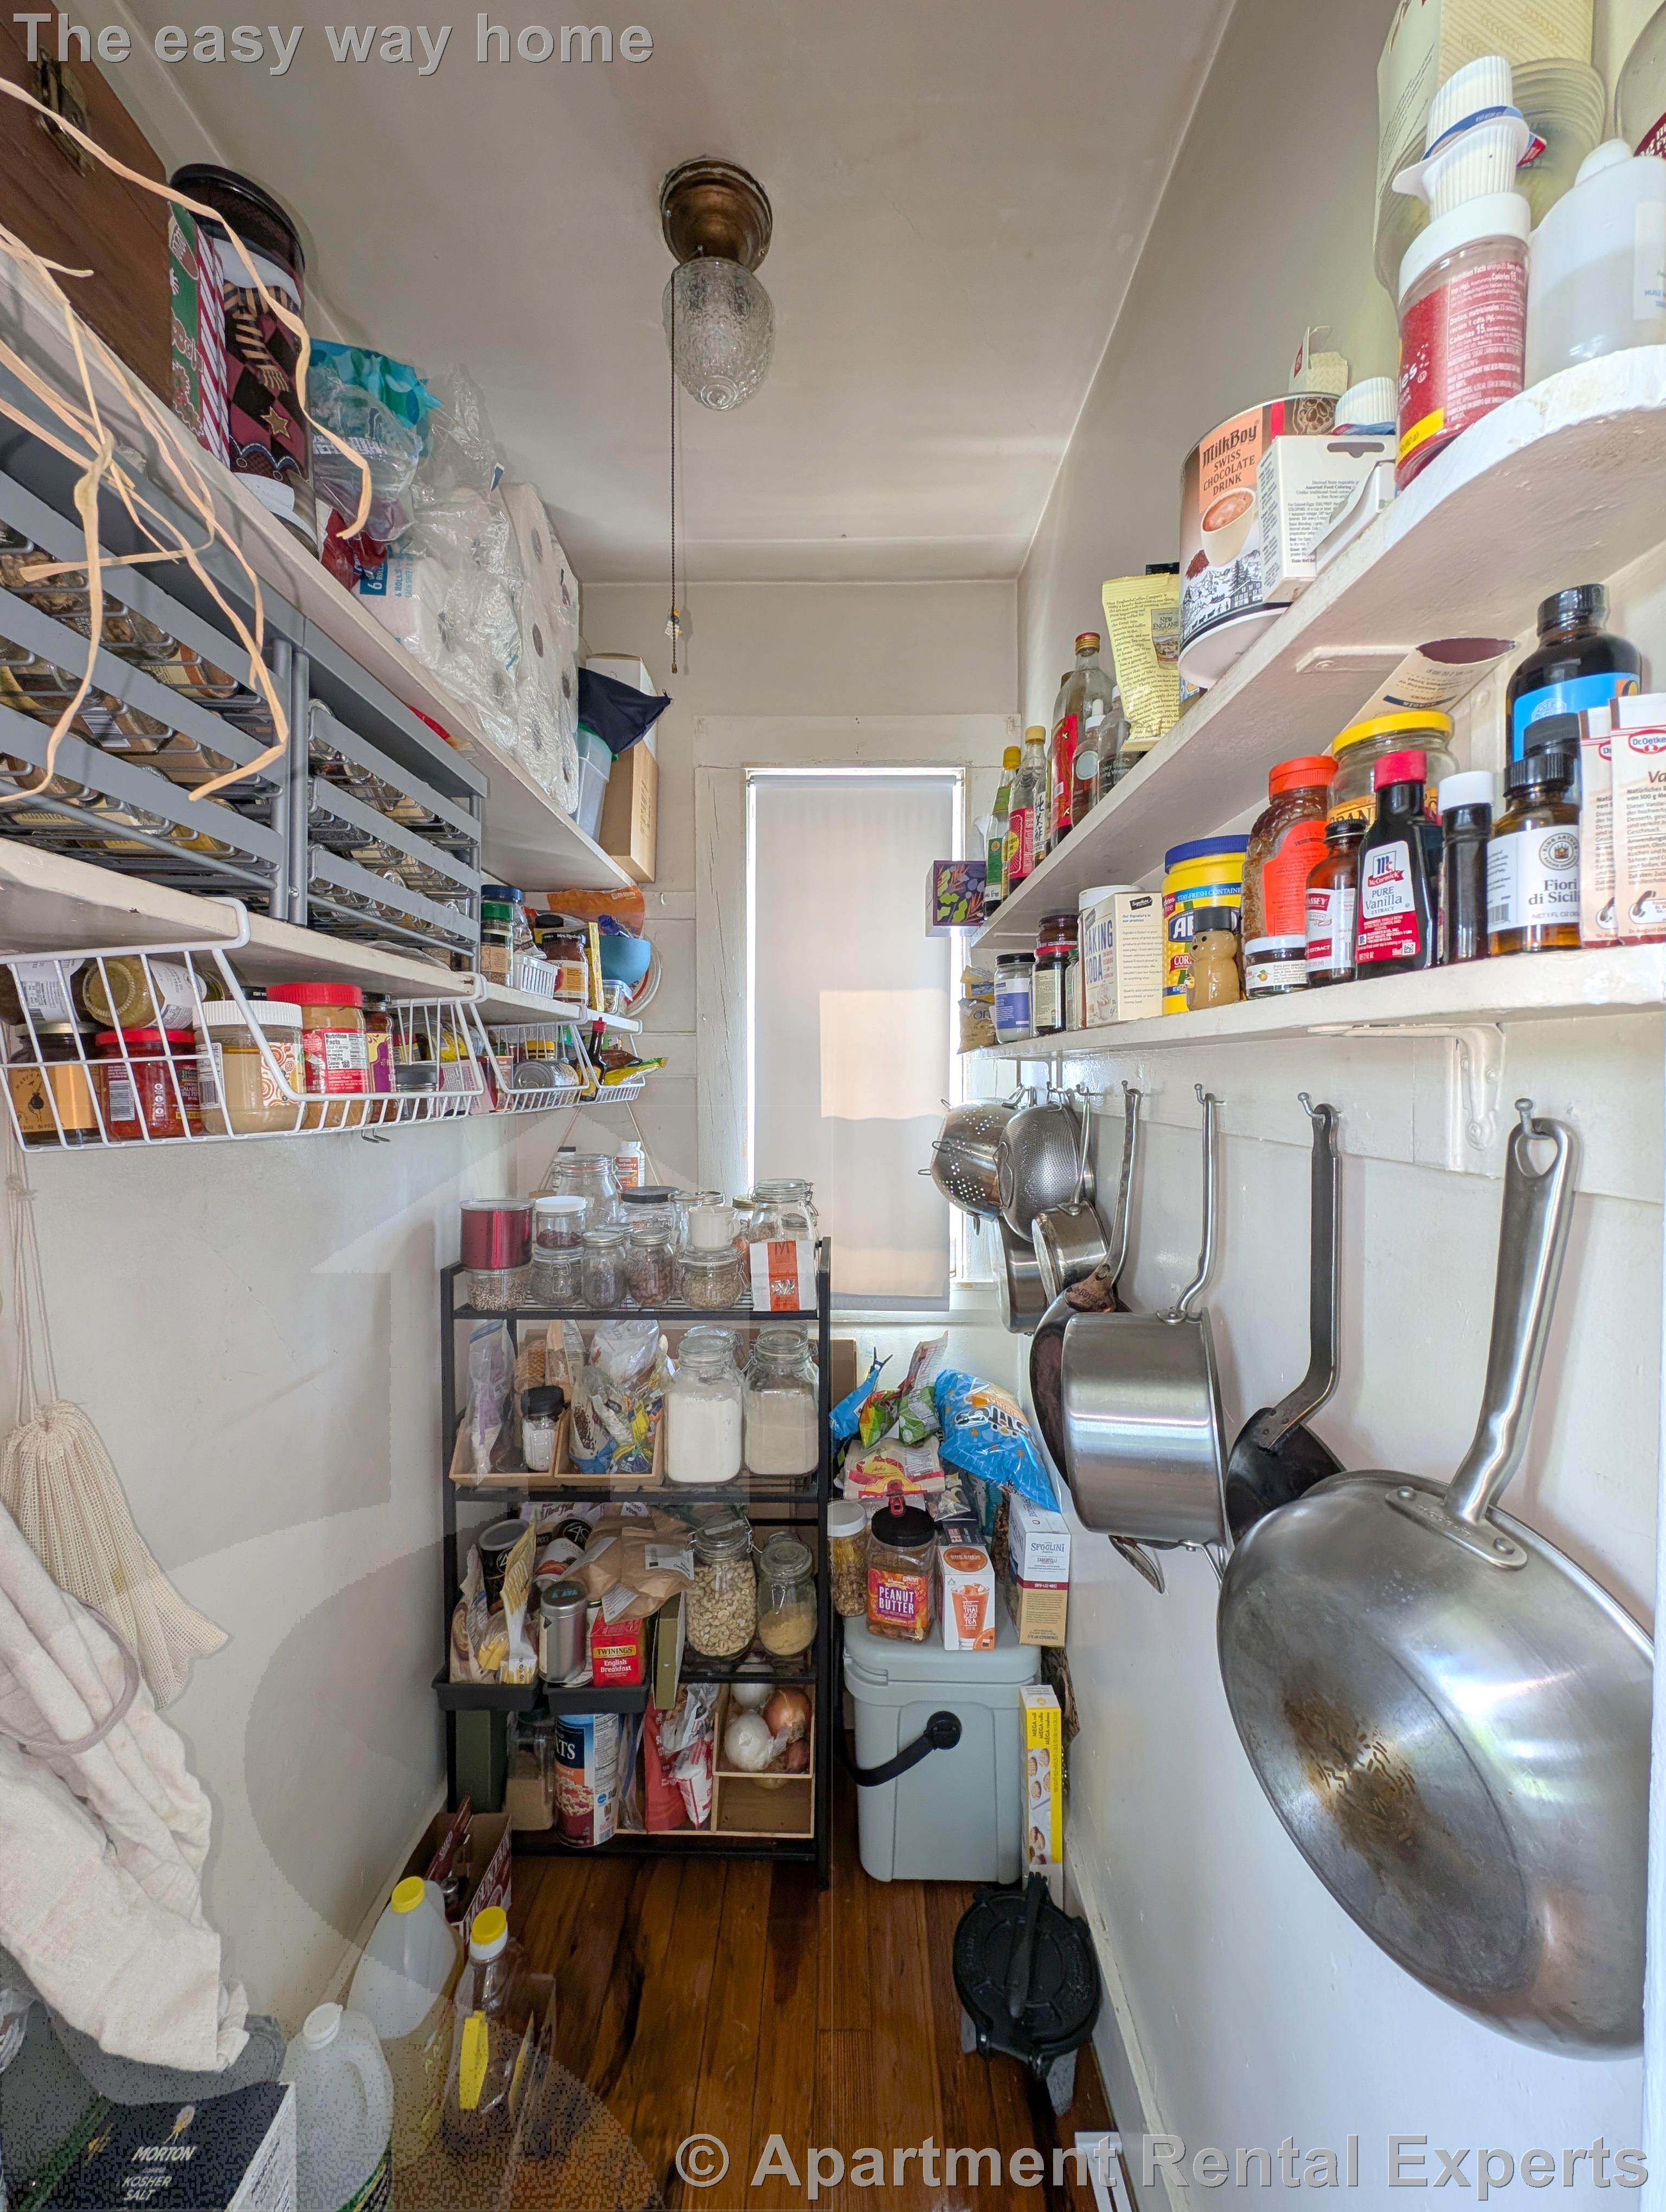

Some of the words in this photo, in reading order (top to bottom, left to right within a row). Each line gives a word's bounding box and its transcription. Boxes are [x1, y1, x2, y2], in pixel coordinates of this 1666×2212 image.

[1451, 270, 1474, 284] Nutrition
[1449, 314, 1468, 325] Datos
[1203, 425, 1257, 468] MilkBoy
[1214, 449, 1241, 472] SWISS
[1203, 455, 1255, 491] CHOCOLATE
[1213, 472, 1242, 496] DRINK
[1153, 621, 1178, 630] ENGLAND
[1632, 736, 1666, 745] Dr.Oetke
[1369, 872, 1400, 886] McCormick
[1544, 878, 1577, 891] Fiori
[1177, 891, 1207, 902] STAY-FRESH
[1208, 887, 1242, 897] CONTAINE
[1372, 886, 1394, 898] PURE
[1528, 893, 1543, 905] di
[1548, 891, 1580, 903] Sicili
[1366, 895, 1402, 910] Vanilla
[1371, 906, 1395, 915] EXTRACT
[1174, 955, 1192, 966] COR
[1031, 1543, 1065, 1553] SFOGLINI
[879, 1586, 914, 1603] PEANUT
[879, 1597, 914, 1614] BUTTER
[597, 1647, 633, 1655] TWININGS
[604, 1659, 627, 1667] English
[132, 2146, 197, 2162] MORTON
[122, 2176, 172, 2187] KOSHER
[124, 2189, 156, 2201] SALT
